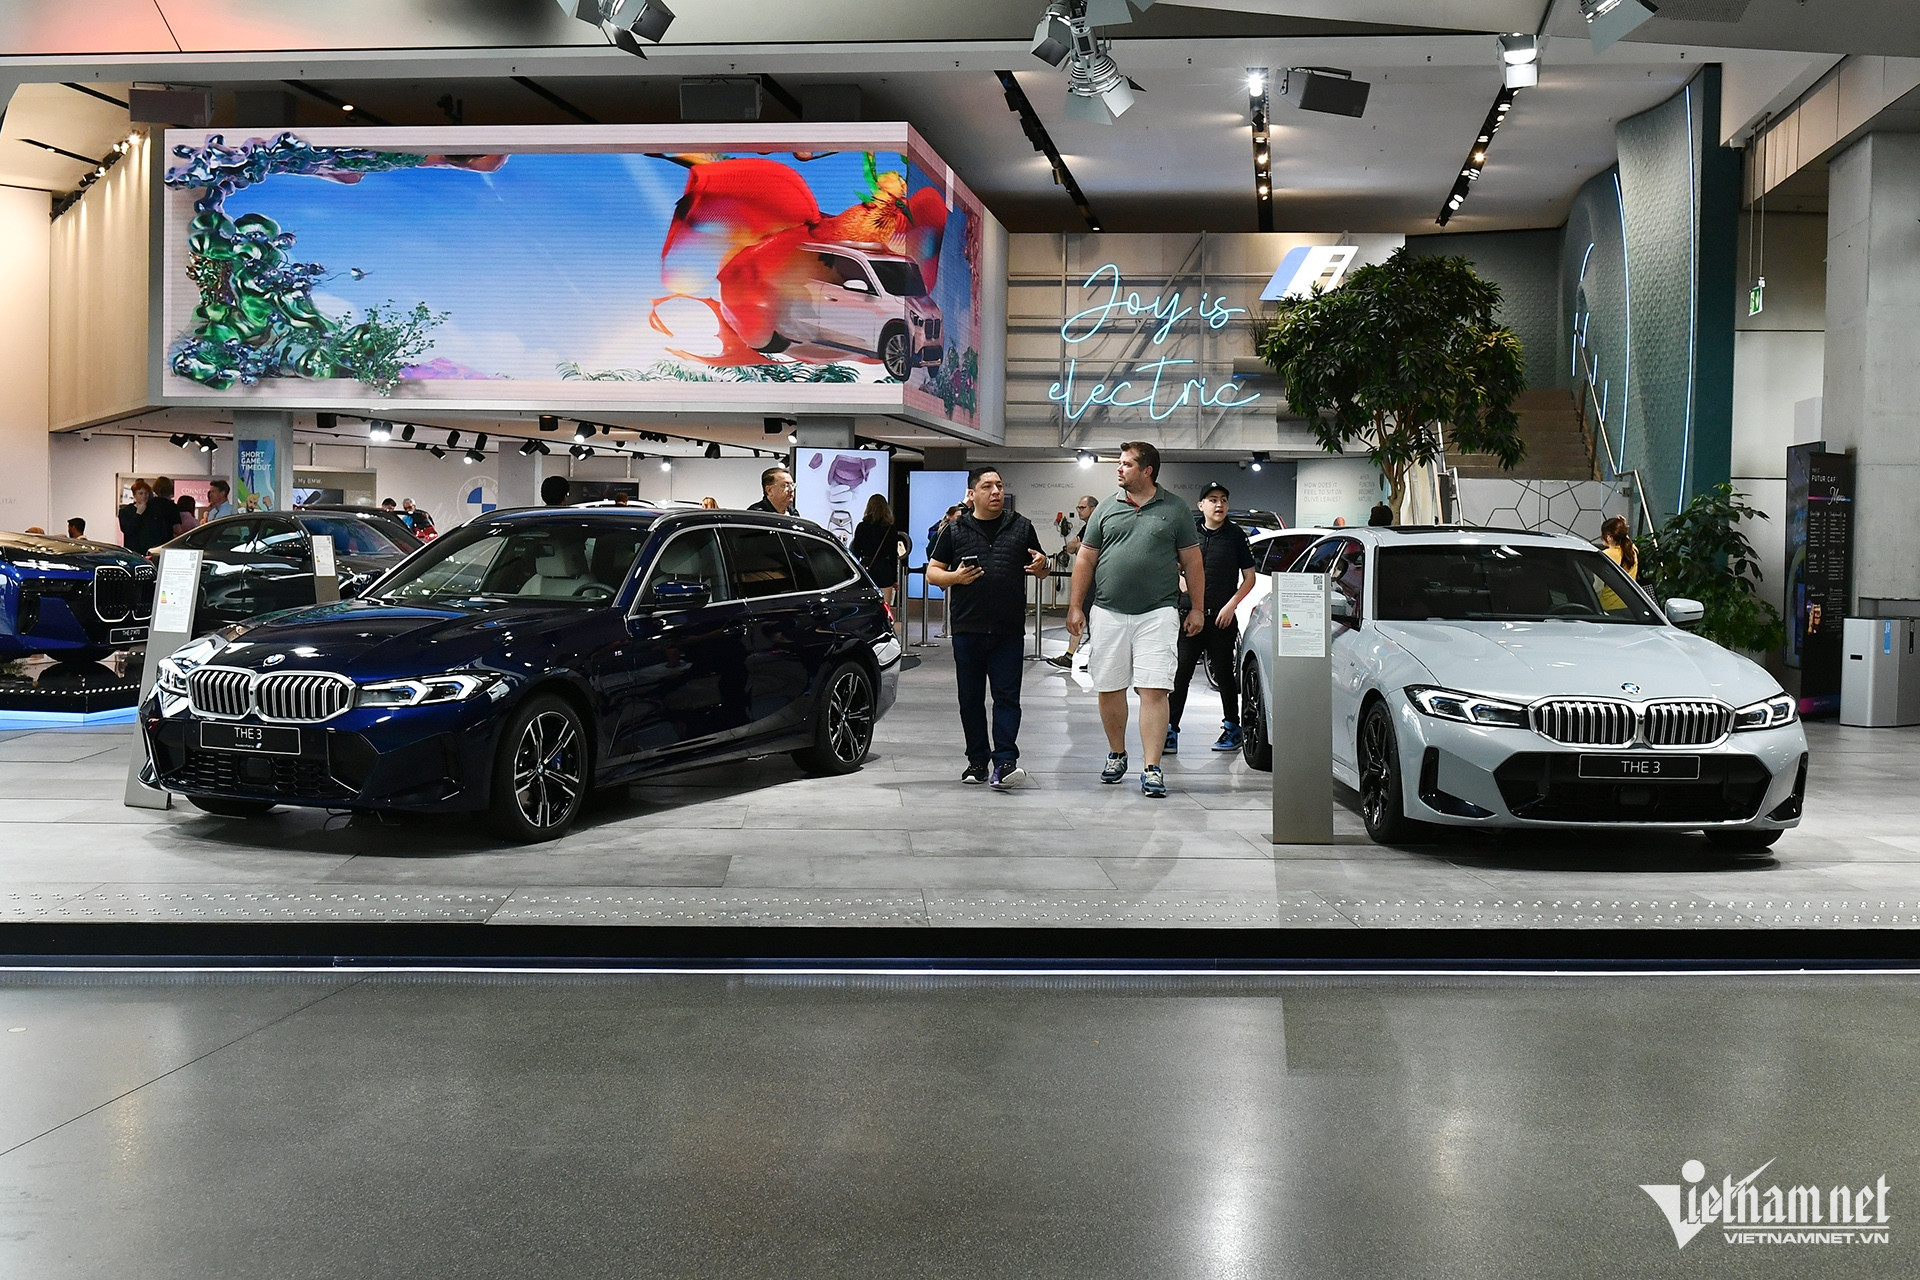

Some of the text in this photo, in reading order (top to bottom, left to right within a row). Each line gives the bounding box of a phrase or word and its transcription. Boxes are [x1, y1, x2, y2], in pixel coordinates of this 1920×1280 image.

[1061, 263, 1246, 345] Joy is
[1048, 355, 1261, 420] electric
[233, 726, 263, 740] THE 3
[1620, 760, 1661, 774] THE 3
